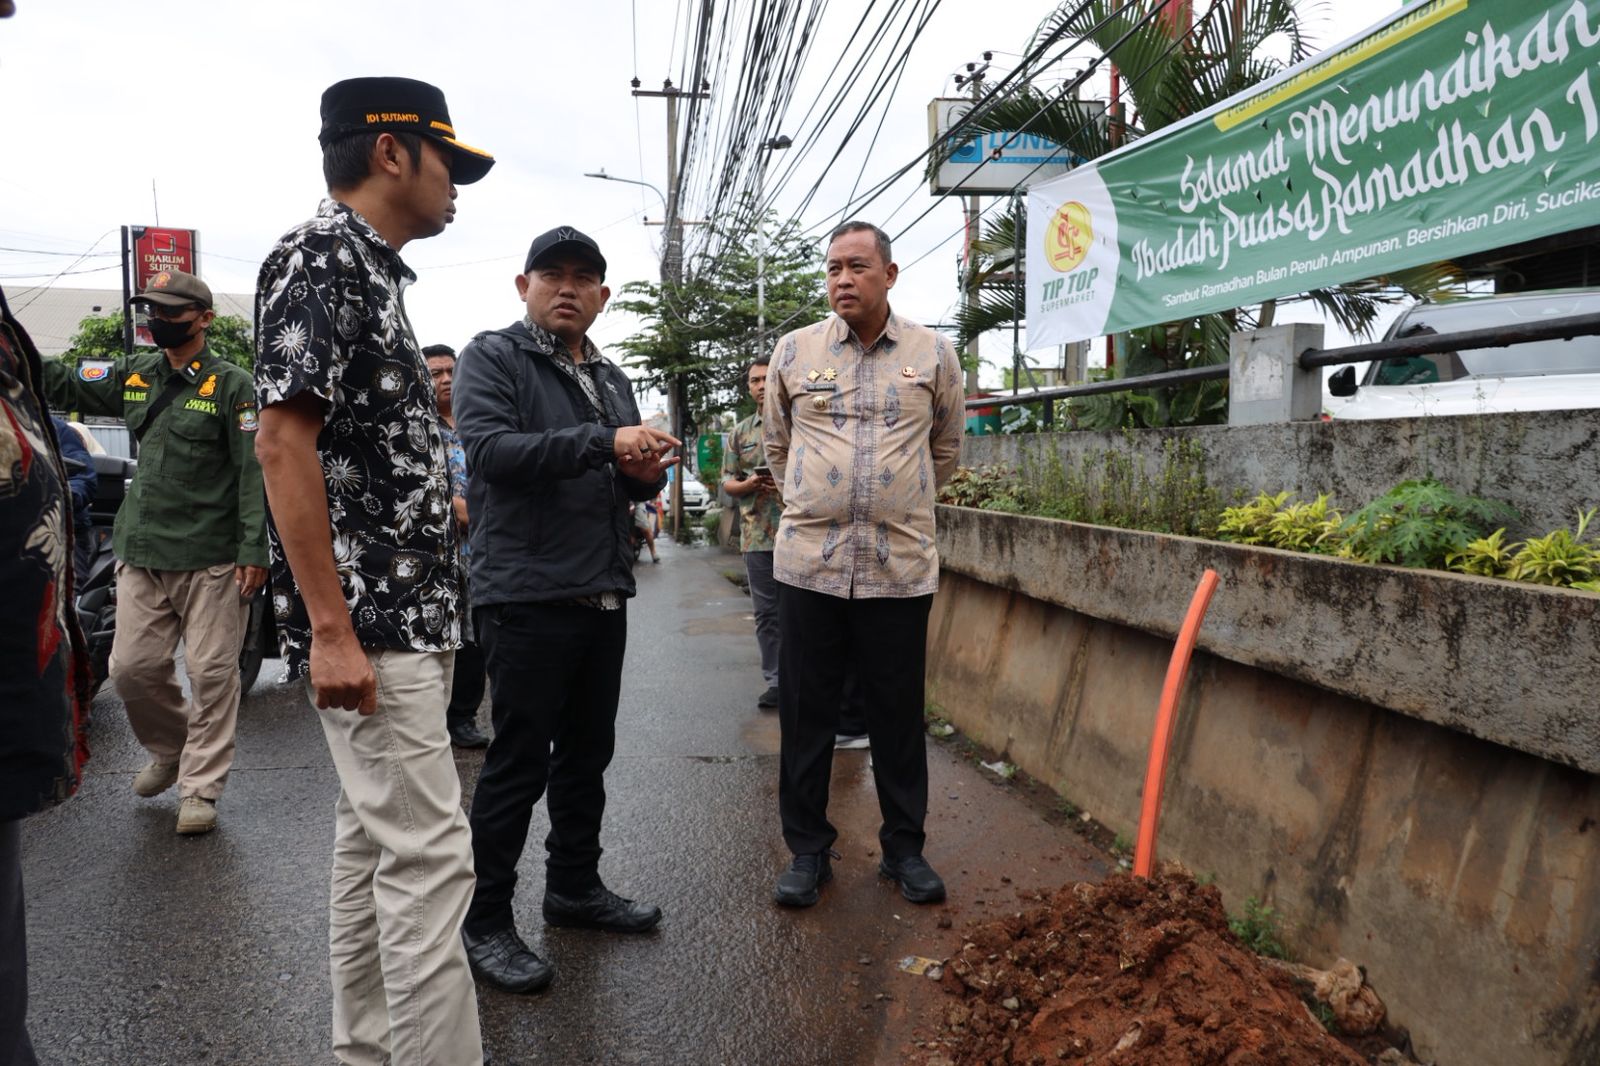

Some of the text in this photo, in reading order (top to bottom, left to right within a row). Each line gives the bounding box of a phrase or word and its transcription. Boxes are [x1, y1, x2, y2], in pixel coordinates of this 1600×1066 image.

[366, 113, 419, 124] IDI SUTANTO
[1179, 0, 1600, 213] Selamat Menunaikan
[1131, 217, 1220, 282] Ibadah
[1218, 190, 1319, 270] Puasa
[1308, 107, 1566, 241] Ramadhan
[144, 254, 185, 264] DJARUM
[1201, 276, 1254, 297] Ramadhan
[1256, 265, 1287, 284] Bulan
[1289, 254, 1329, 274] Penuh
[1331, 237, 1402, 265] Ampunan.
[1406, 213, 1488, 247] Bersihkan
[1492, 198, 1529, 224] Diri,
[149, 262, 179, 271] SUPER
[1042, 267, 1099, 302] TIP TOP
[1040, 290, 1095, 313] SUPERMARKET
